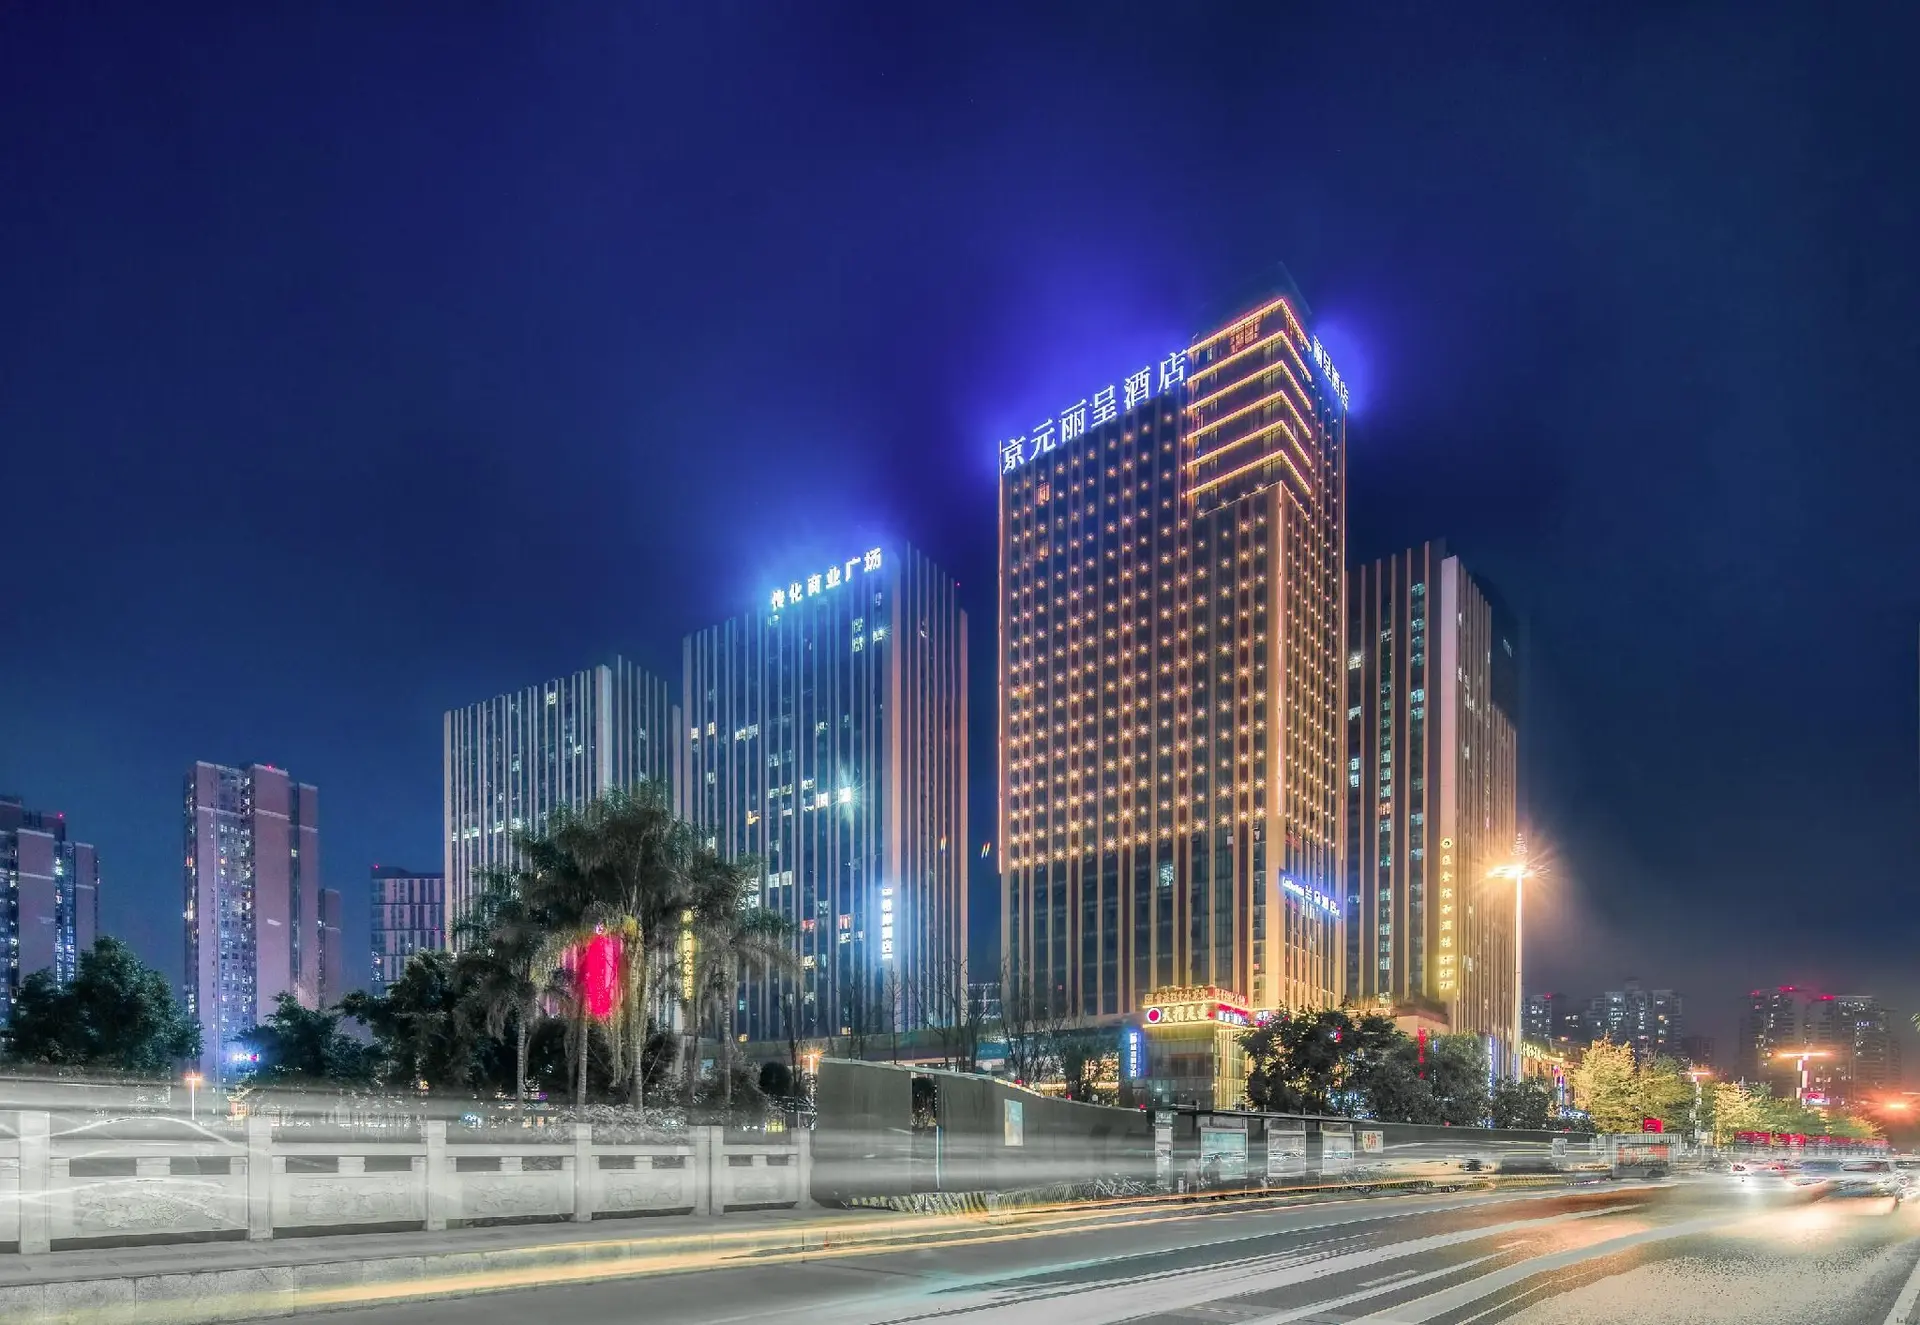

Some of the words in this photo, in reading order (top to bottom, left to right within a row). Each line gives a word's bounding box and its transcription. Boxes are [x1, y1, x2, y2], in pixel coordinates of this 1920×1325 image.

[1002, 347, 1188, 475] 京元丽呈酒店
